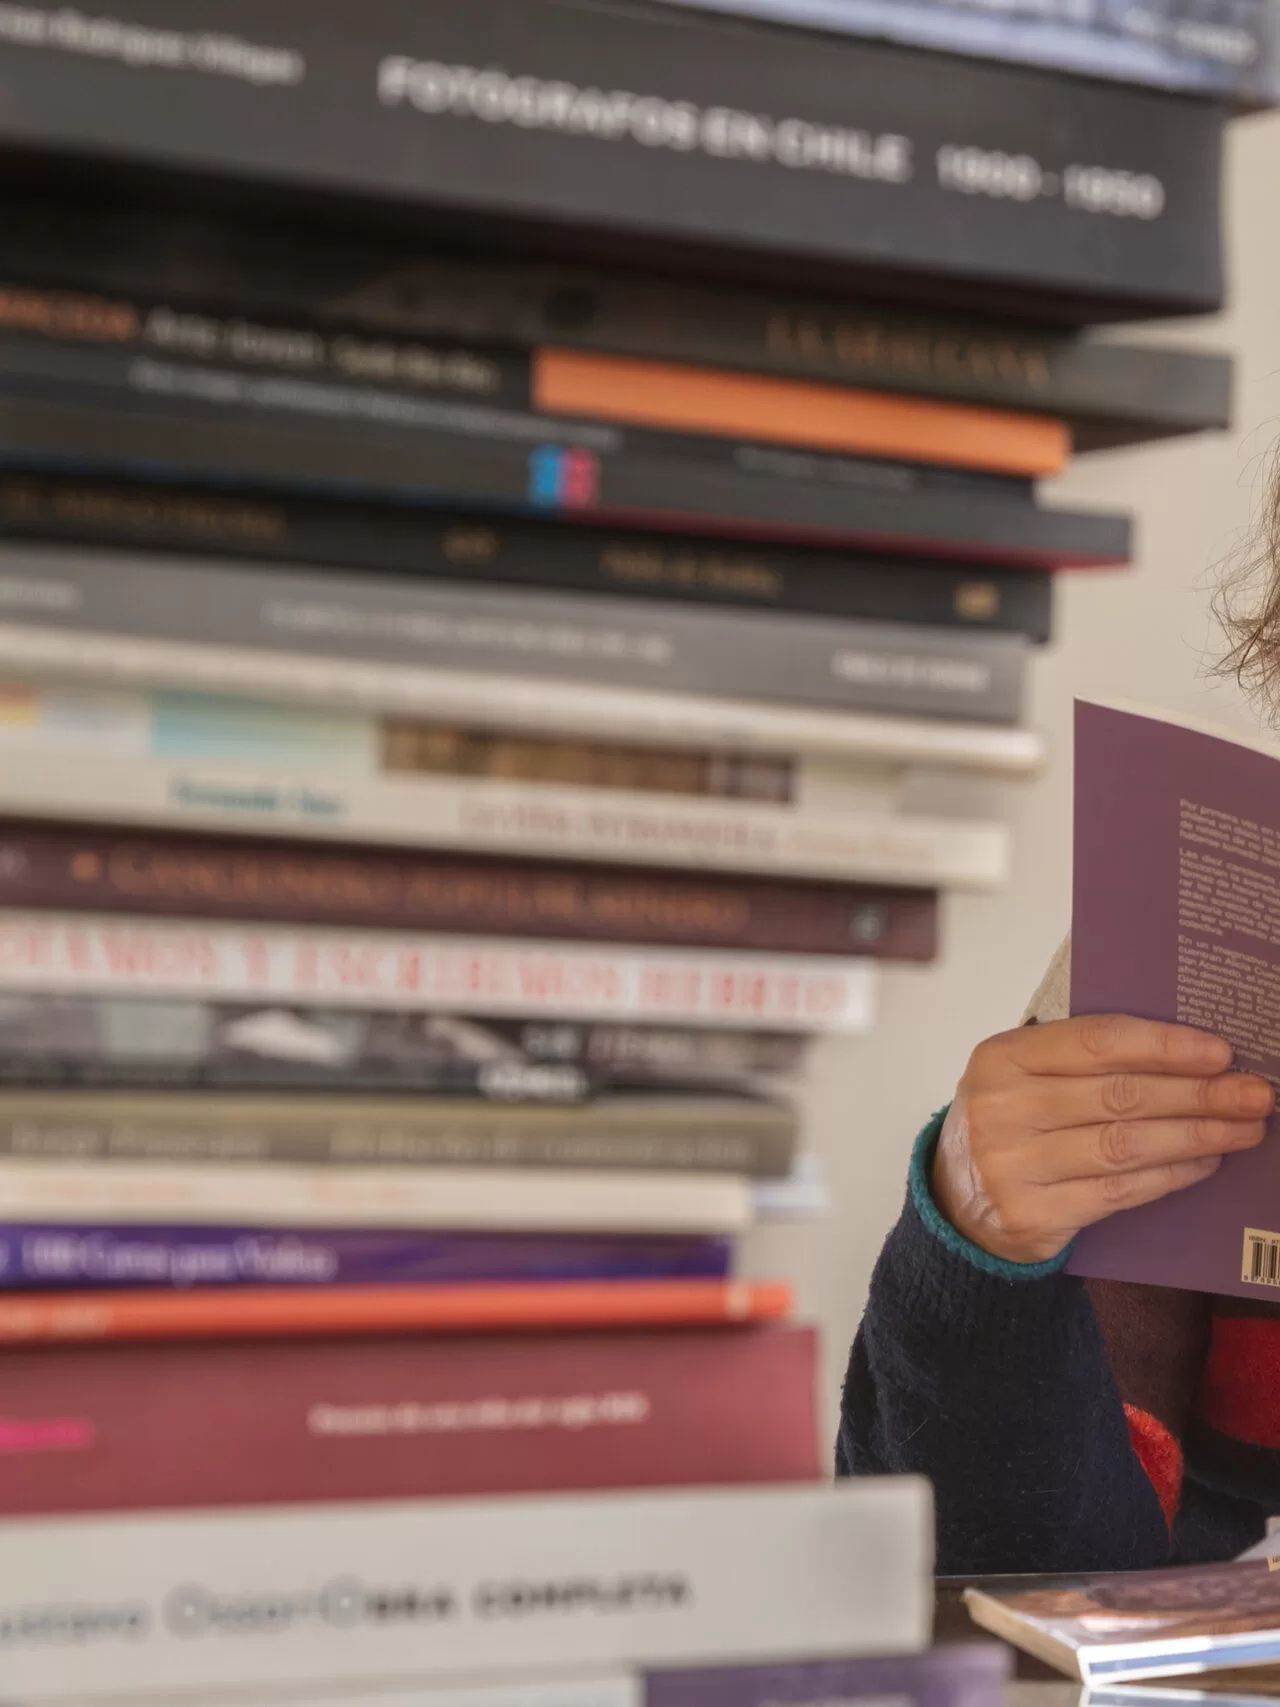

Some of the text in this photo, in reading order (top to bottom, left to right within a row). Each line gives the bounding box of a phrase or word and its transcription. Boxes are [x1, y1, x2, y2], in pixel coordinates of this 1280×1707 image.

[378, 55, 699, 150] FOTÓGRAFOS
[702, 107, 773, 162] EN
[774, 119, 911, 181] CHILE
[473, 1572, 690, 1620] COMPLETA
